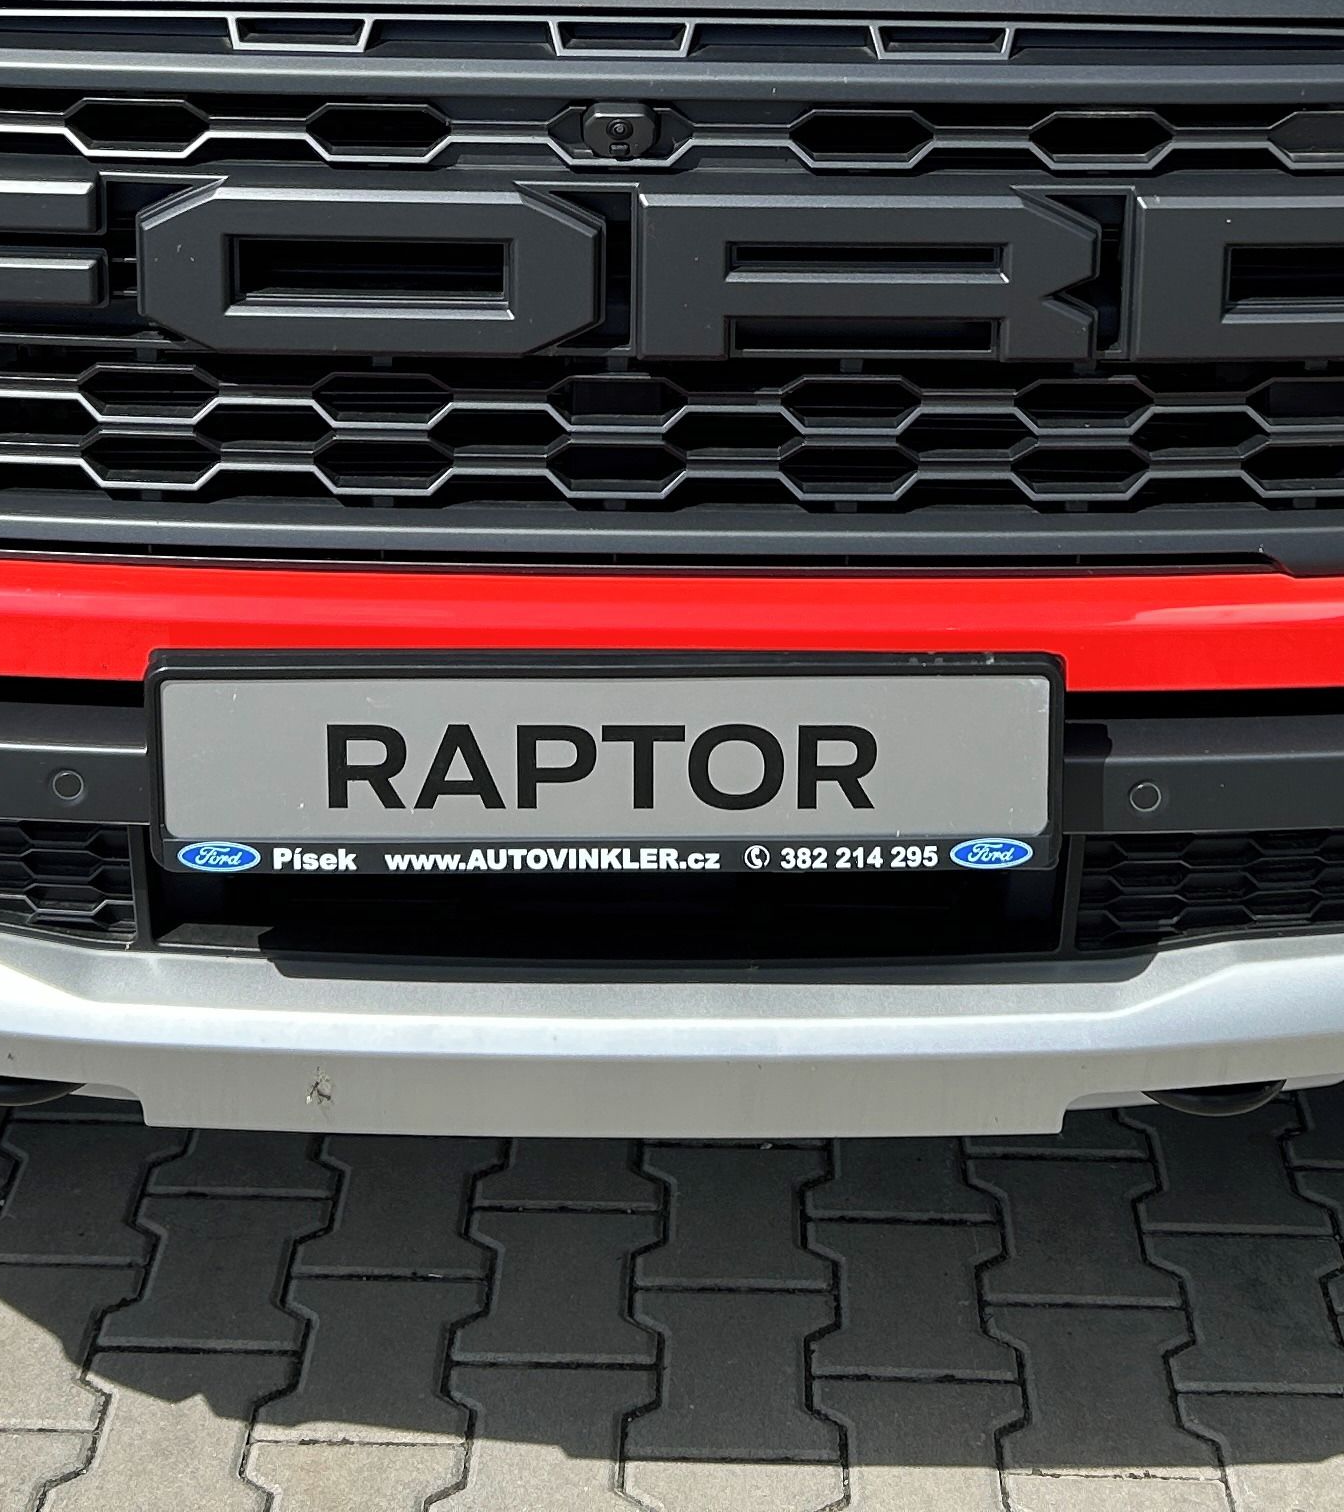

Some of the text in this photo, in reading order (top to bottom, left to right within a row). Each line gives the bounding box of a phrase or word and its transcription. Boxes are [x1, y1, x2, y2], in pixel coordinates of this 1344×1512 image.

[326, 723, 878, 811] RAPTOR
[272, 846, 358, 871] Písek
[384, 847, 721, 871] www.AUTOVINKLER.cz
[780, 847, 828, 869] 382
[835, 846, 885, 869] 214
[890, 845, 939, 868] 295
